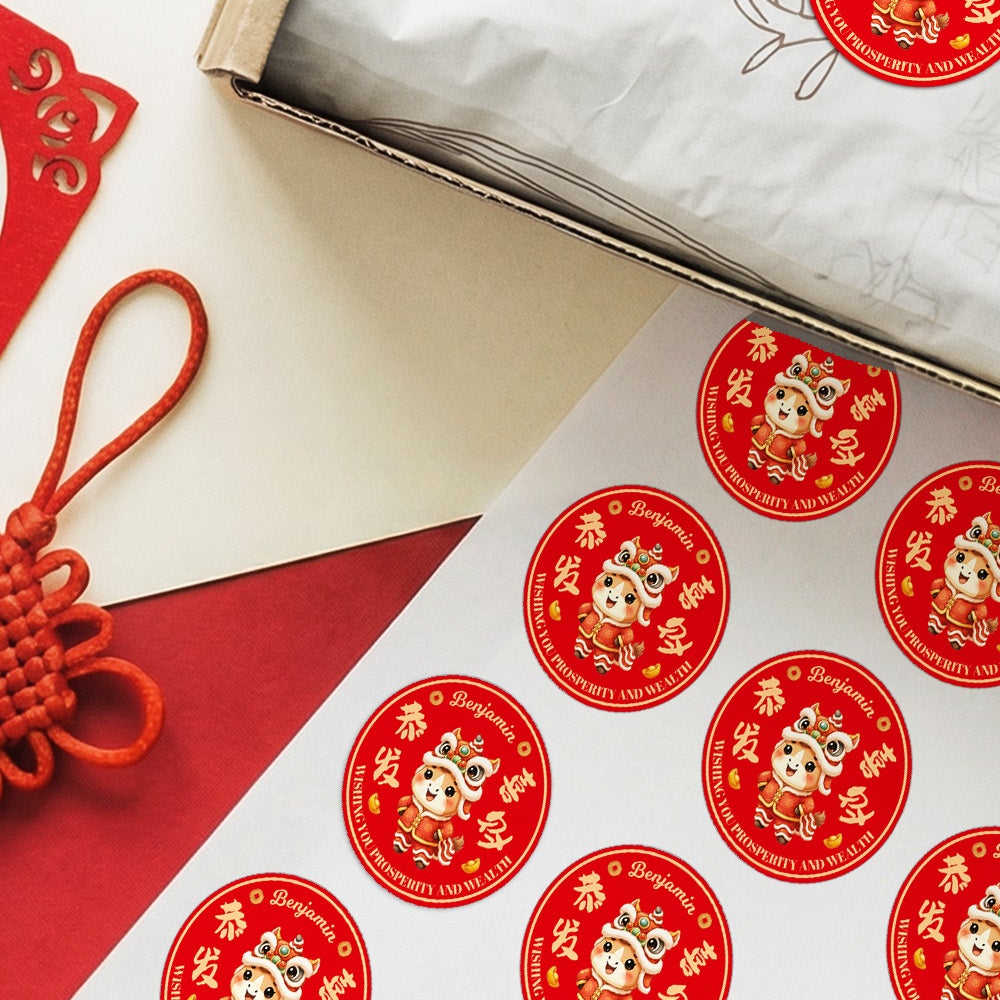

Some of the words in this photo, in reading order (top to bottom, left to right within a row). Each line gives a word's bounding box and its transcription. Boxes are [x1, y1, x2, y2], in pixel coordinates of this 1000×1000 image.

[829, 8, 848, 33] YOU
[845, 31, 921, 74] PROSPERITY
[925, 60, 954, 74] AND
[746, 327, 779, 364] 恭
[706, 386, 719, 442] WISHING
[712, 441, 728, 465] YOU
[724, 464, 788, 509] PROSPERITY
[791, 498, 817, 510] AND
[817, 471, 864, 505] WEALTH
[925, 485, 958, 526] 恭
[574, 510, 607, 551] 恭
[627, 500, 694, 552] Benjamin
[533, 573, 547, 630] WISHING
[885, 549, 898, 606] WISHING
[892, 605, 908, 630] YOU
[904, 629, 969, 675] PROSPERITY
[973, 664, 999, 676] AND
[539, 629, 555, 654] YOU
[551, 653, 614, 699] PROSPERITY
[618, 688, 644, 700] AND
[644, 660, 692, 695] WEALTH
[753, 676, 786, 717] 恭
[807, 665, 875, 719] Benjamin
[395, 701, 428, 742] 恭
[449, 690, 516, 744] Benjamin
[712, 740, 725, 799] WISHING
[352, 765, 366, 824] WISHING
[718, 798, 734, 824] YOU
[358, 823, 373, 848] YOU
[730, 823, 795, 870] PROSPERITY
[825, 831, 874, 866] WEALTH
[369, 847, 433, 895] PROSPERITY
[463, 855, 512, 891] WEALTH
[799, 859, 826, 871] AND
[938, 853, 971, 895] 恭
[436, 883, 463, 896] AND
[573, 871, 606, 914] 恭
[627, 861, 696, 916] Benjamin
[214, 899, 247, 942] 恭
[269, 889, 336, 944] Benjamin
[531, 937, 544, 997] WISHING
[897, 919, 910, 979] WISHING
